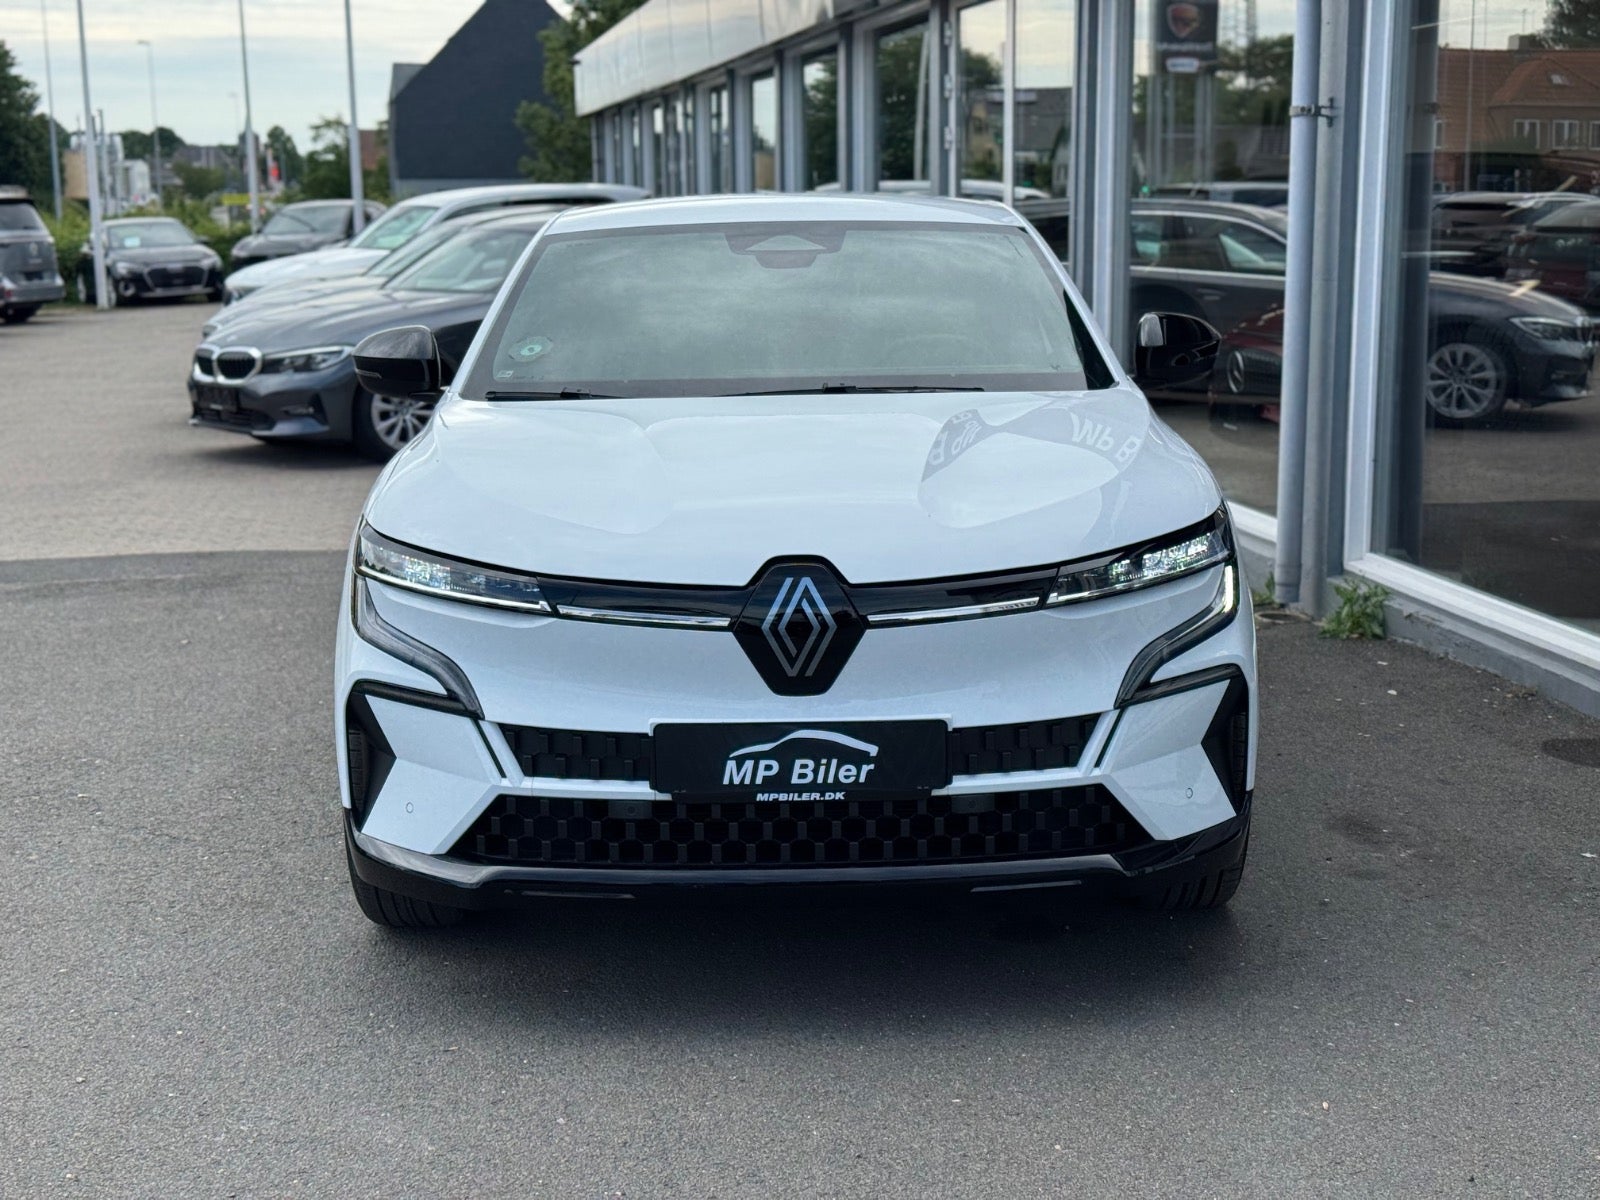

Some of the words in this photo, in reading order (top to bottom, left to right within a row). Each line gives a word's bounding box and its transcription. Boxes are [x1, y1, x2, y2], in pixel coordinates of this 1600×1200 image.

[722, 759, 780, 785] MP
[790, 758, 875, 784] Biler
[756, 791, 846, 802] MPBILER.DK
